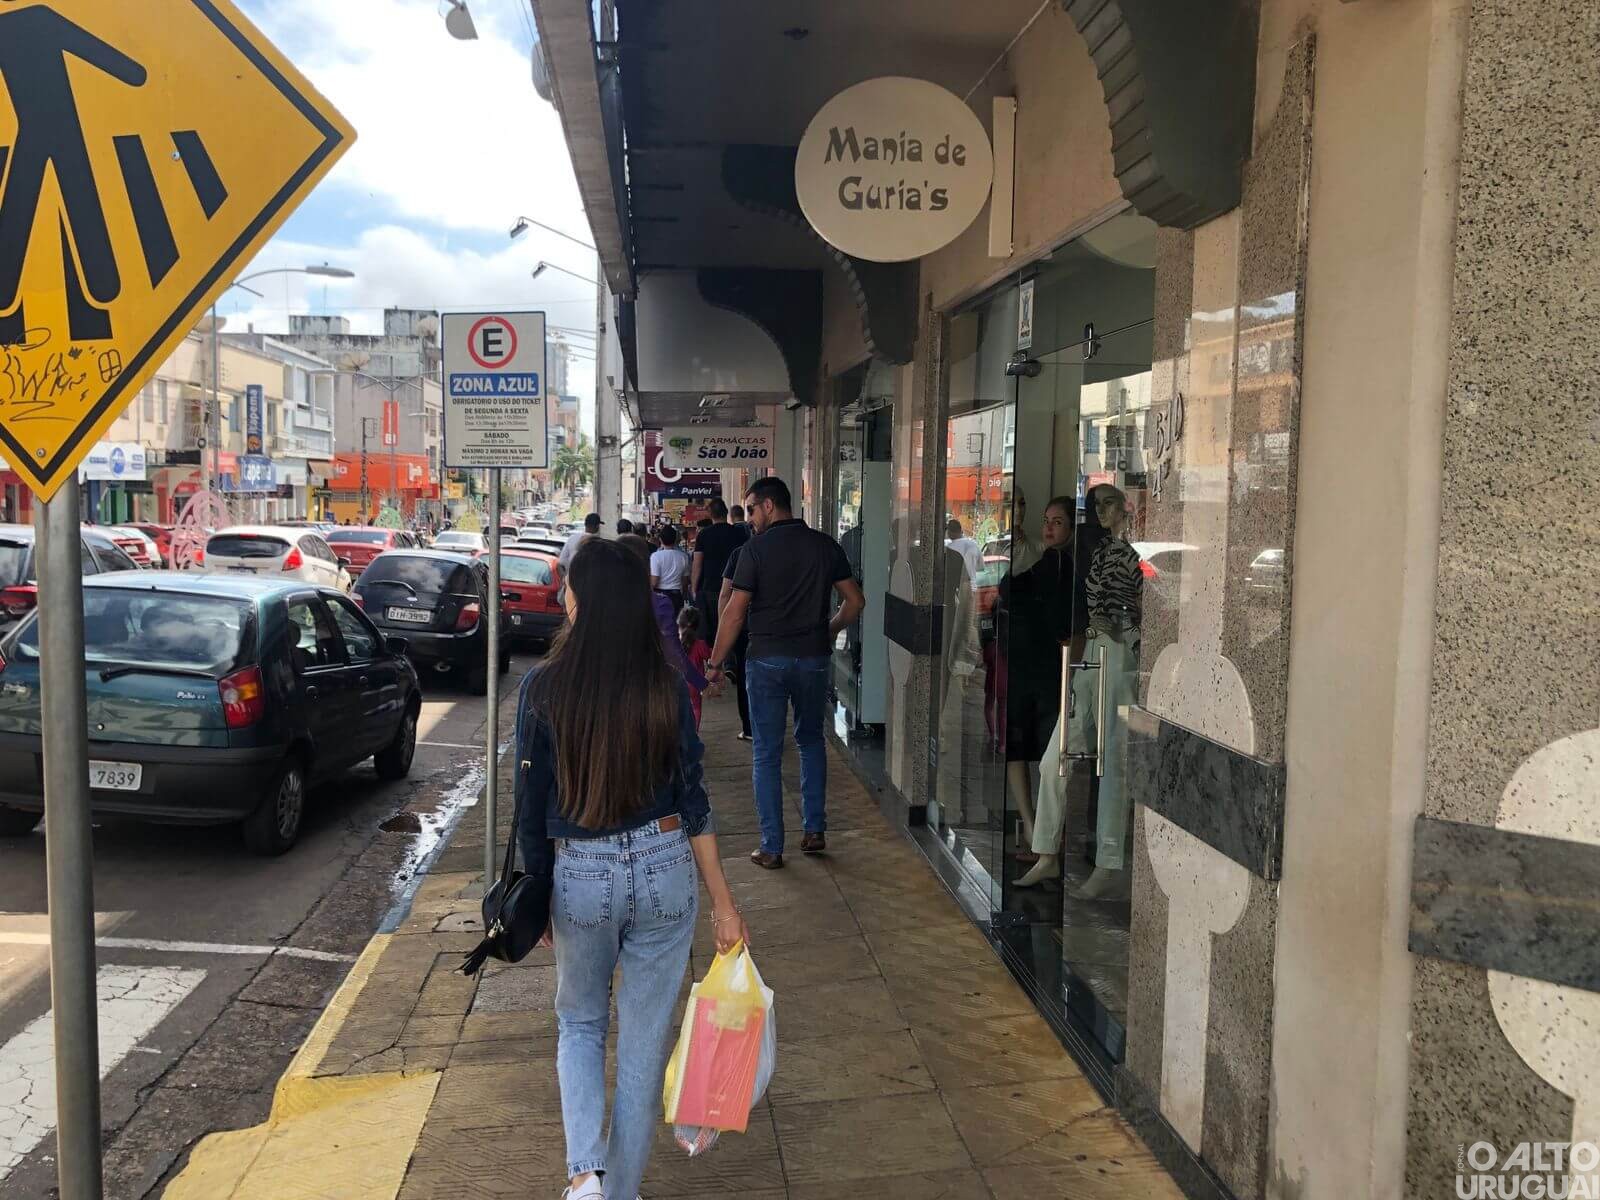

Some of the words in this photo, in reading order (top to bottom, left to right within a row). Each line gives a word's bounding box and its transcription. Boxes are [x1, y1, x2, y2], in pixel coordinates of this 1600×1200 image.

[824, 126, 922, 165] Mania
[934, 134, 966, 166] de
[838, 176, 949, 211] Guria's
[482, 328, 503, 357] E
[453, 377, 494, 392] ZONA
[498, 377, 536, 392] AZUL
[702, 436, 767, 445] FARMÁCIAS
[698, 445, 727, 459] São
[731, 445, 768, 459] João
